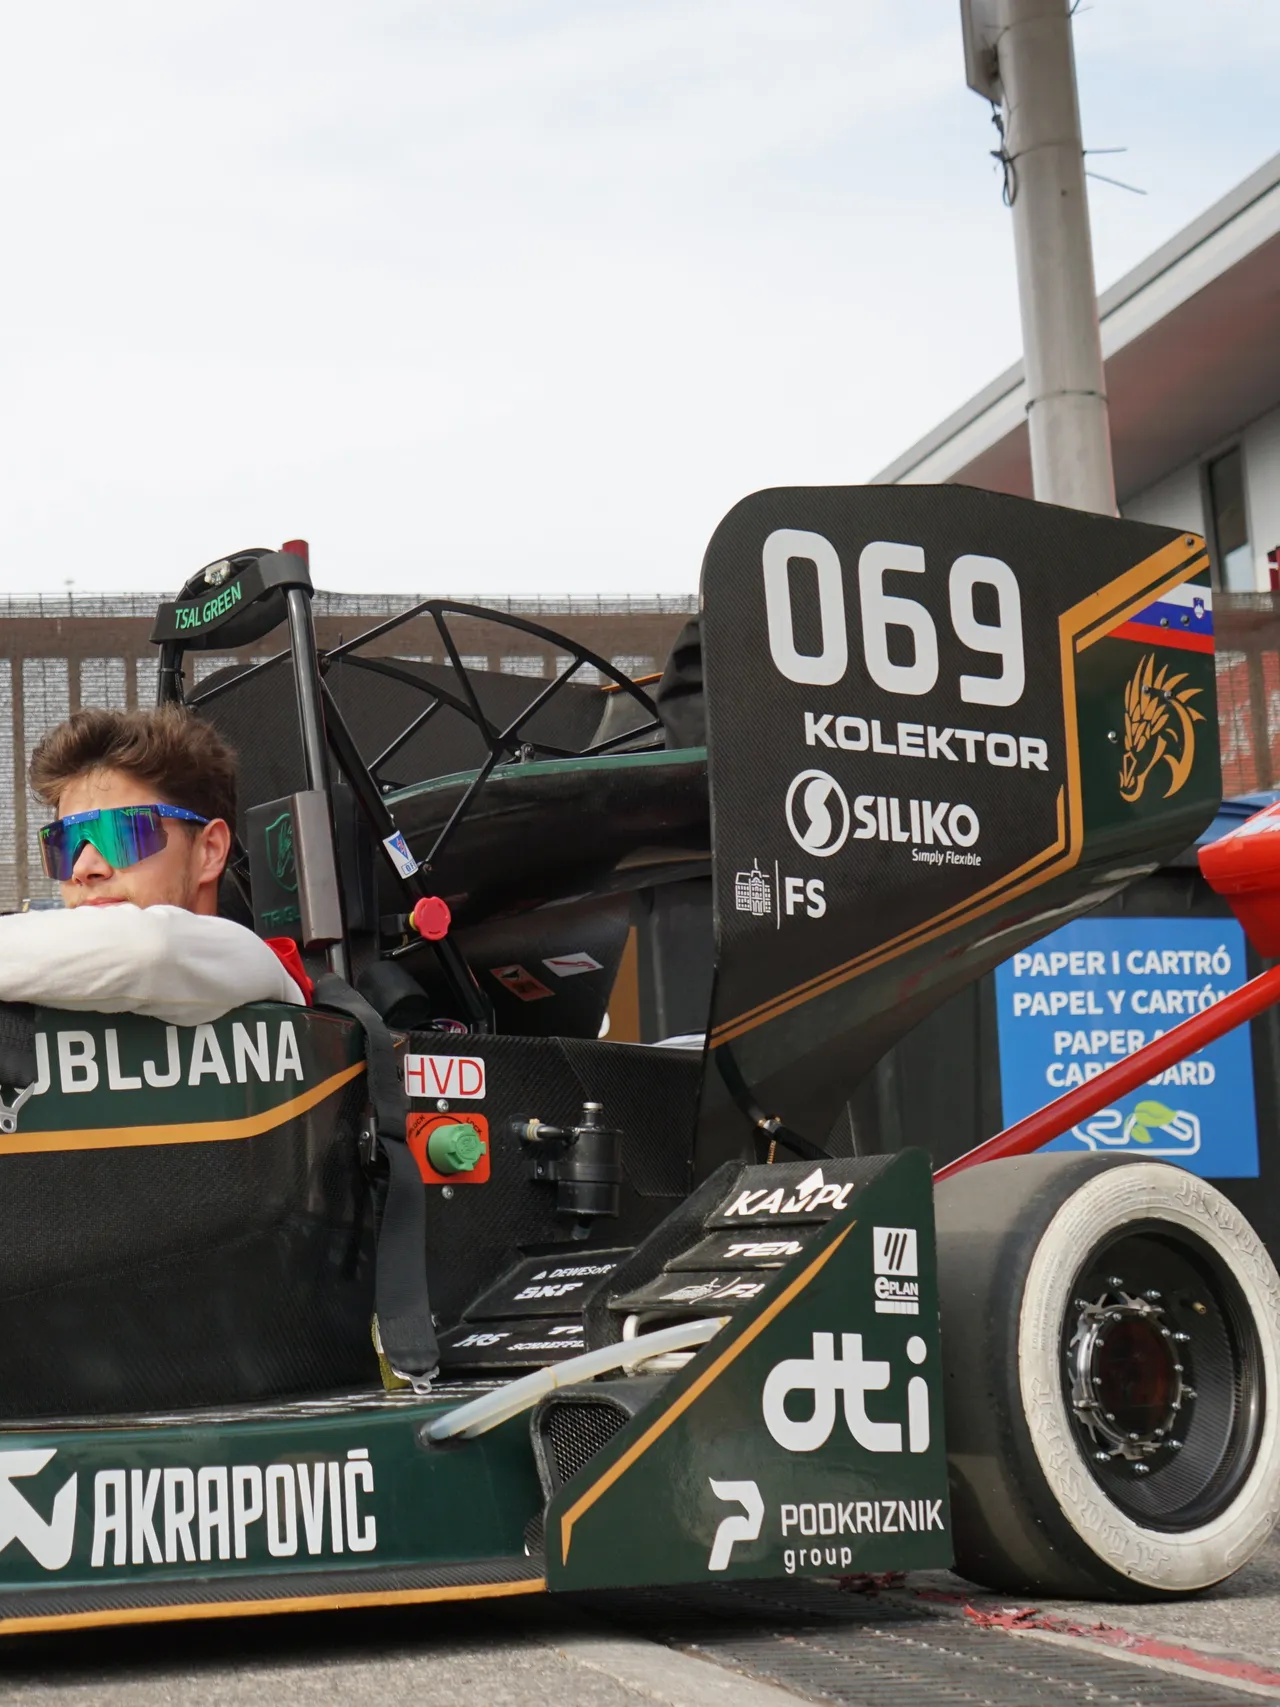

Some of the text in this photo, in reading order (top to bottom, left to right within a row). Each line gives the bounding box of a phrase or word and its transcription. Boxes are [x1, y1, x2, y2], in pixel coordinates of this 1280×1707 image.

[175, 581, 242, 630] TSAL GREEN
[762, 528, 1026, 707] 069
[803, 711, 1050, 772] KOLEKTOR
[853, 795, 980, 848] SILIKO
[912, 848, 982, 868] Simply Flexible
[785, 877, 827, 919] FS
[1013, 944, 1231, 977] PAPER I CARTRÓ
[1013, 990, 1104, 1016] PAPEL
[1107, 990, 1126, 1015] Y
[1054, 1029, 1145, 1056] PAPER
[405, 1055, 484, 1096] HVD
[1046, 1061, 1216, 1087] CARARD
[513, 1282, 584, 1300] SKF
[874, 1276, 919, 1299] ePLAN
[762, 1331, 930, 1453] dti
[781, 1500, 945, 1536] PODKRIZNIK
[784, 1545, 853, 1574] group
